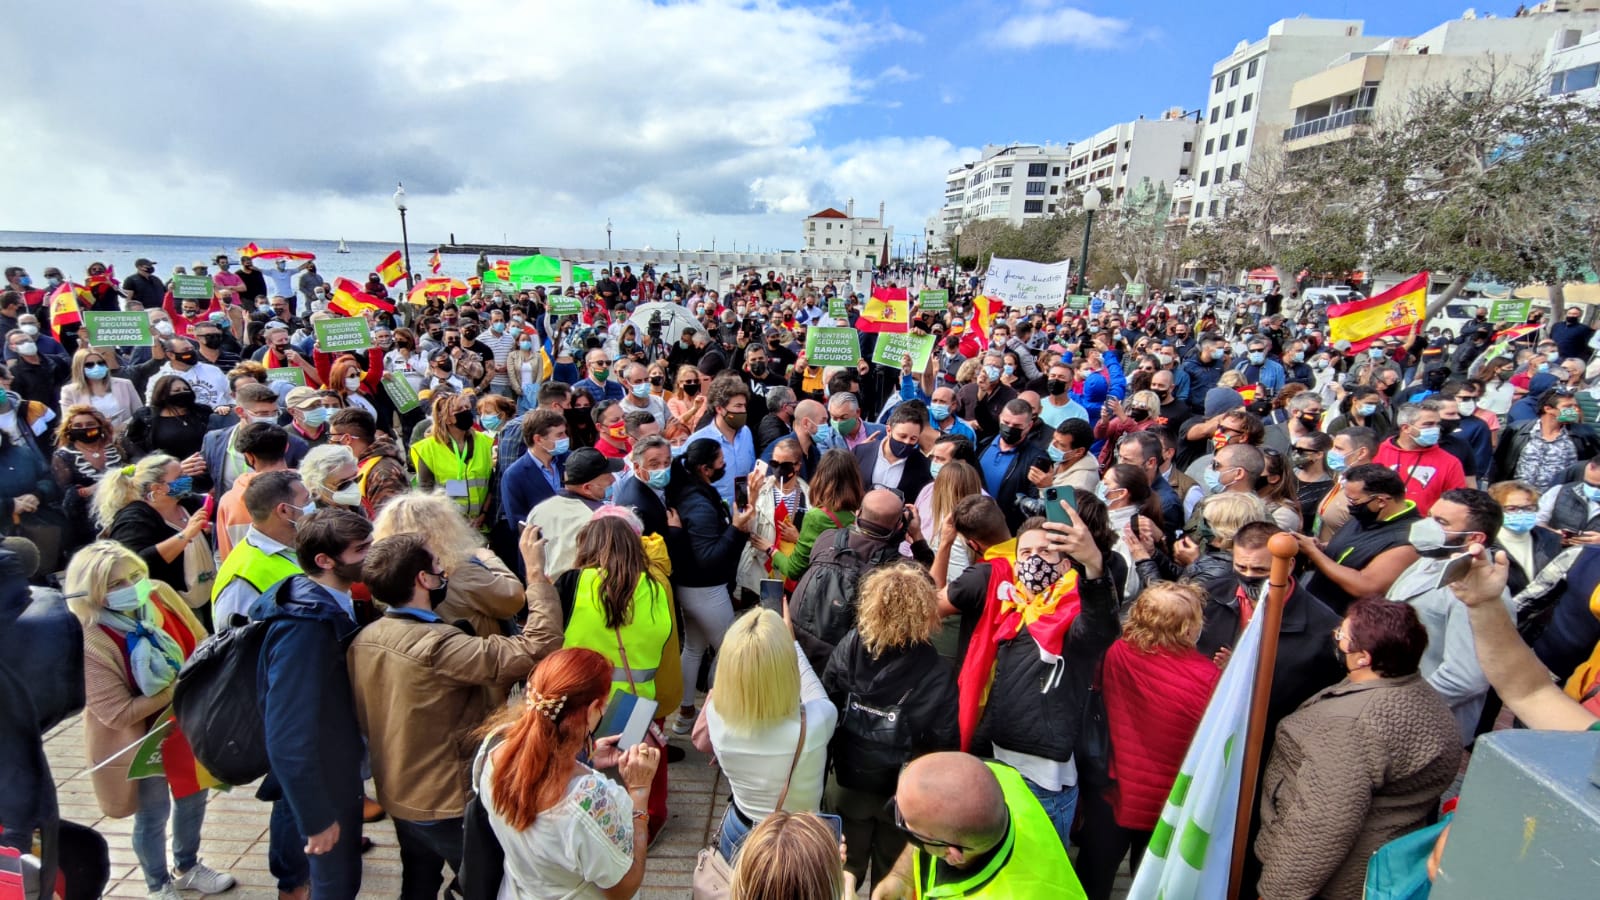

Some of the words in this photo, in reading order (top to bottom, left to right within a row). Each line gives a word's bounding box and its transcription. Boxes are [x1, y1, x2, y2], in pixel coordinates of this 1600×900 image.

[813, 332, 853, 340] FRONTERAS
[327, 339, 364, 347] SEGUROS
[814, 346, 853, 354] BARRIOS
[813, 353, 853, 361] SEGUROS
